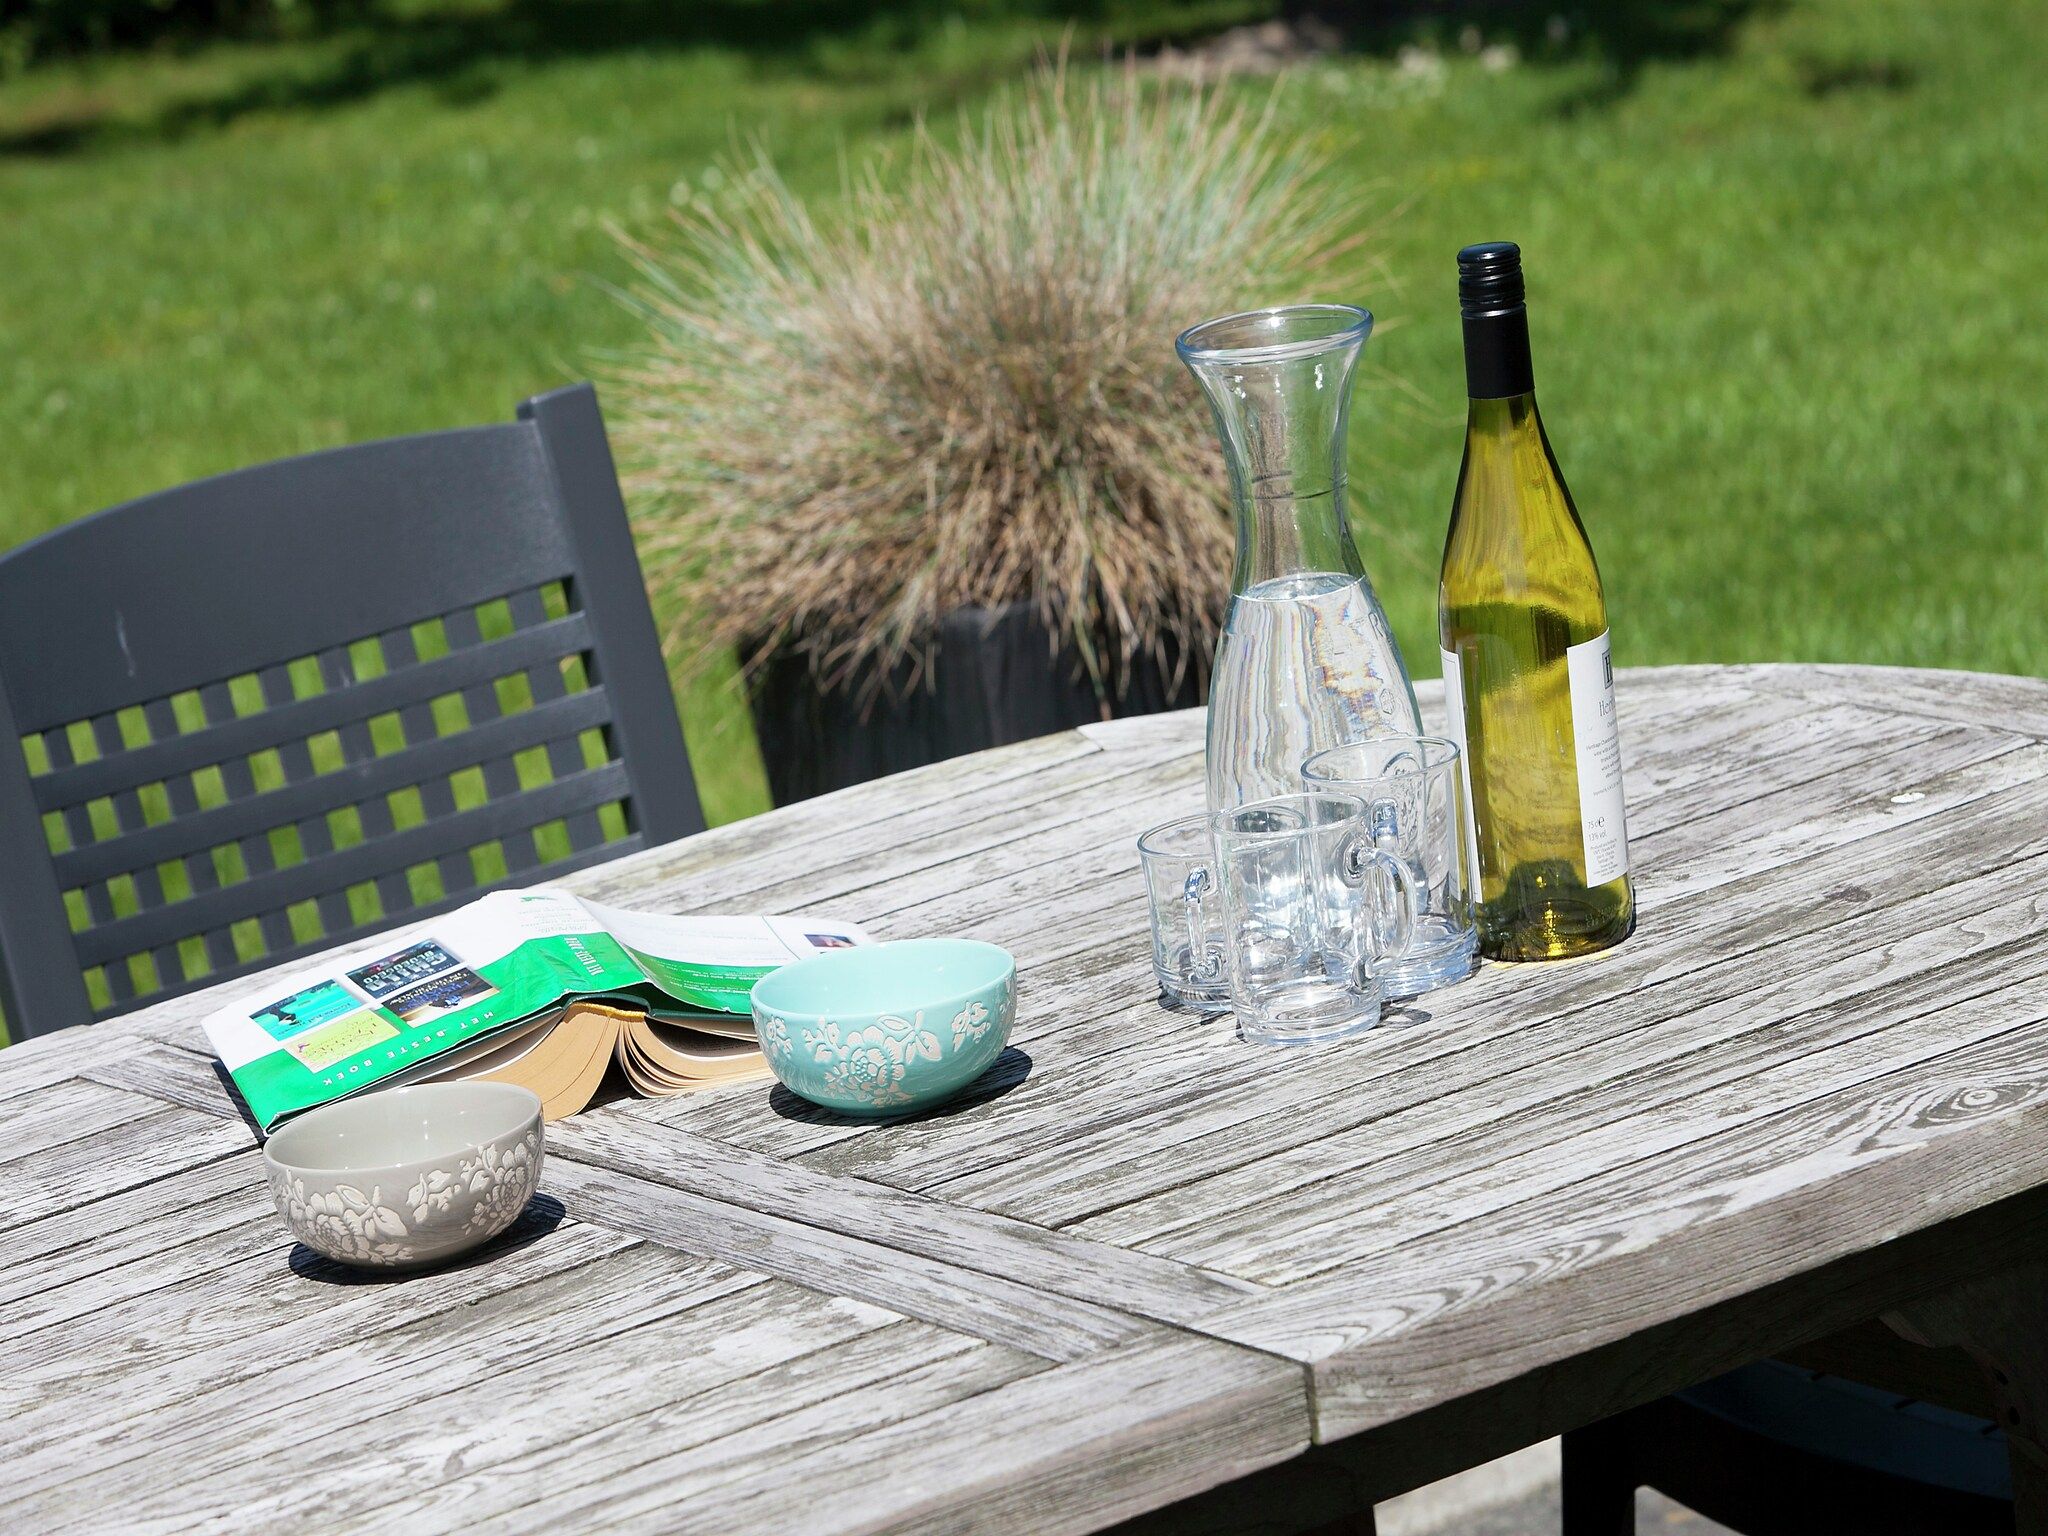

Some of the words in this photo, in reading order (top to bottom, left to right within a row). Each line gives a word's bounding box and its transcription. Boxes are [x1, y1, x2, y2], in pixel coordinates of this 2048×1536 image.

[459, 1011, 494, 1031] HET
[387, 1029, 447, 1059] BESTE
[323, 1058, 374, 1086] BOEK
